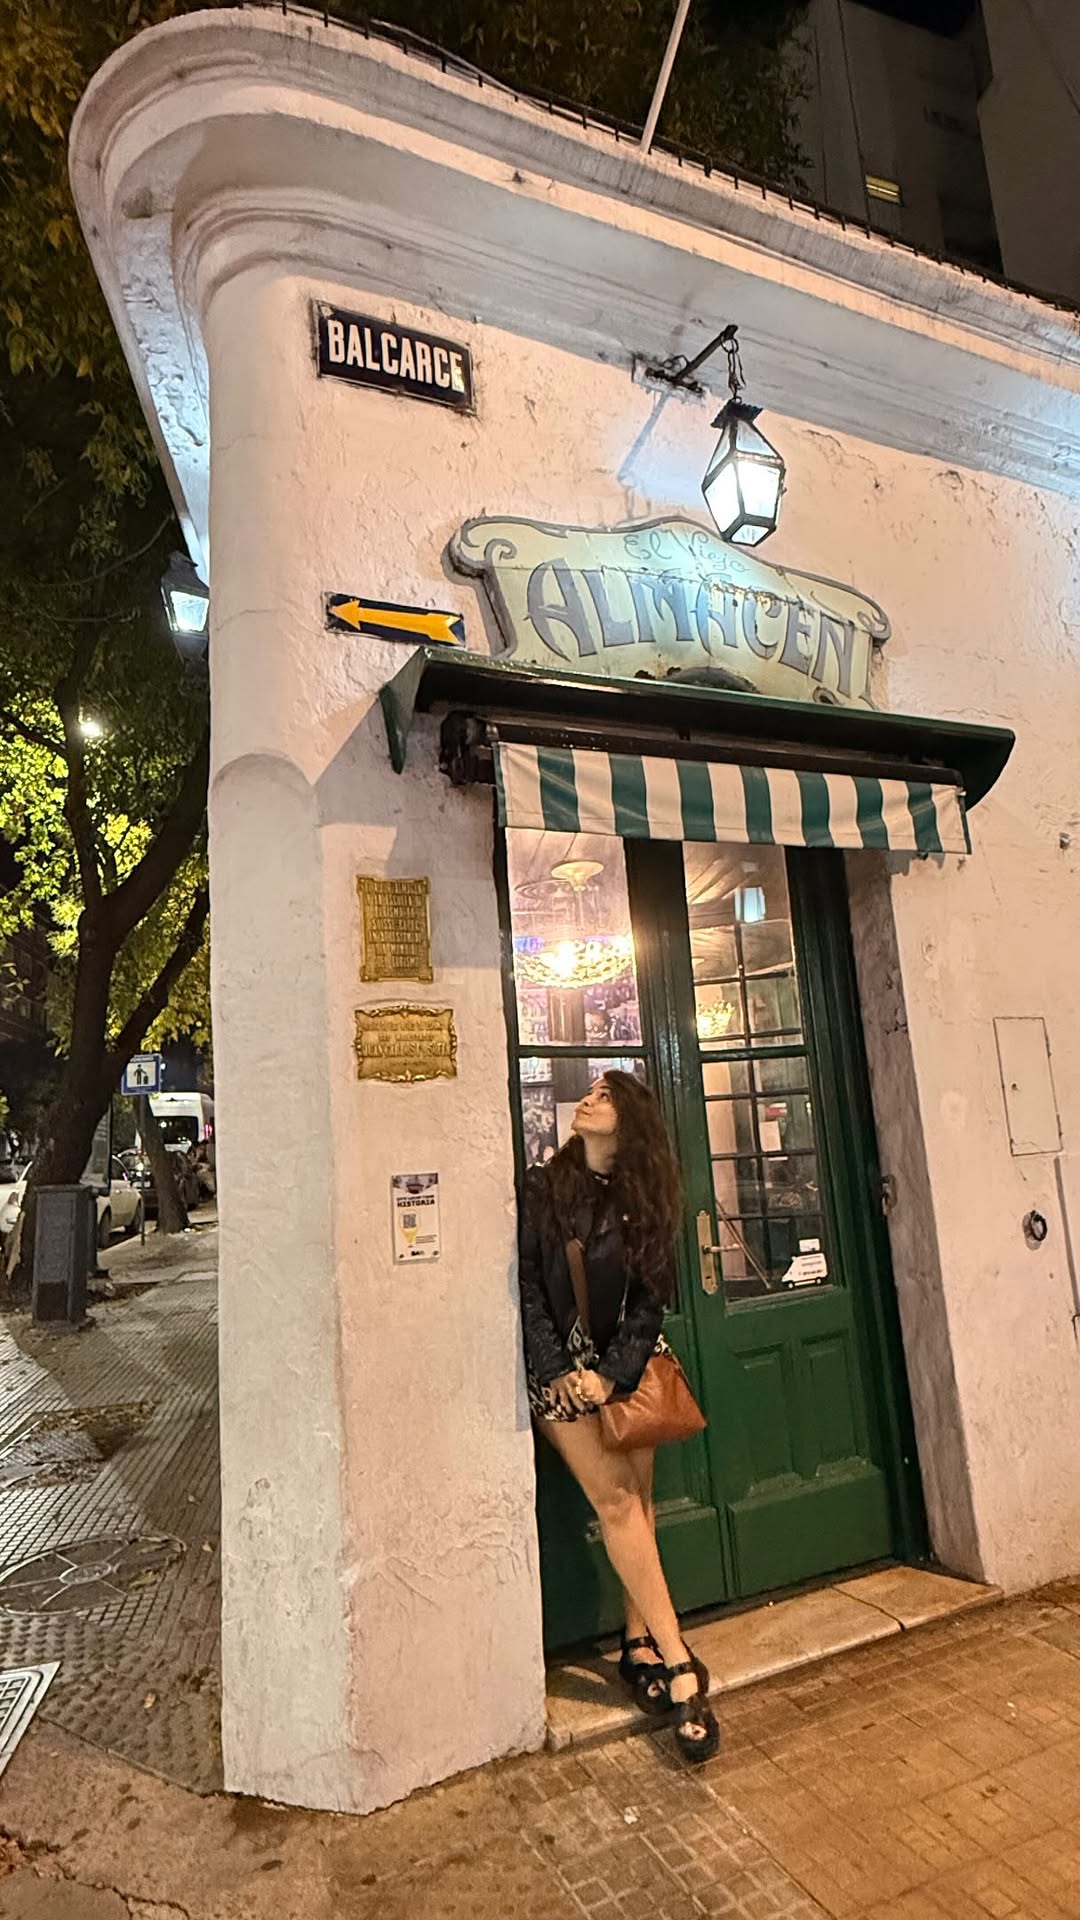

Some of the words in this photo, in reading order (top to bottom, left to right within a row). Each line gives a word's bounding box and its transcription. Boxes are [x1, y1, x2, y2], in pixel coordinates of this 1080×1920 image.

[327, 319, 465, 393] BALCARCE
[623, 531, 672, 560] El
[523, 558, 858, 698] ALMACEN
[397, 1199, 435, 1208] HISTORIA
